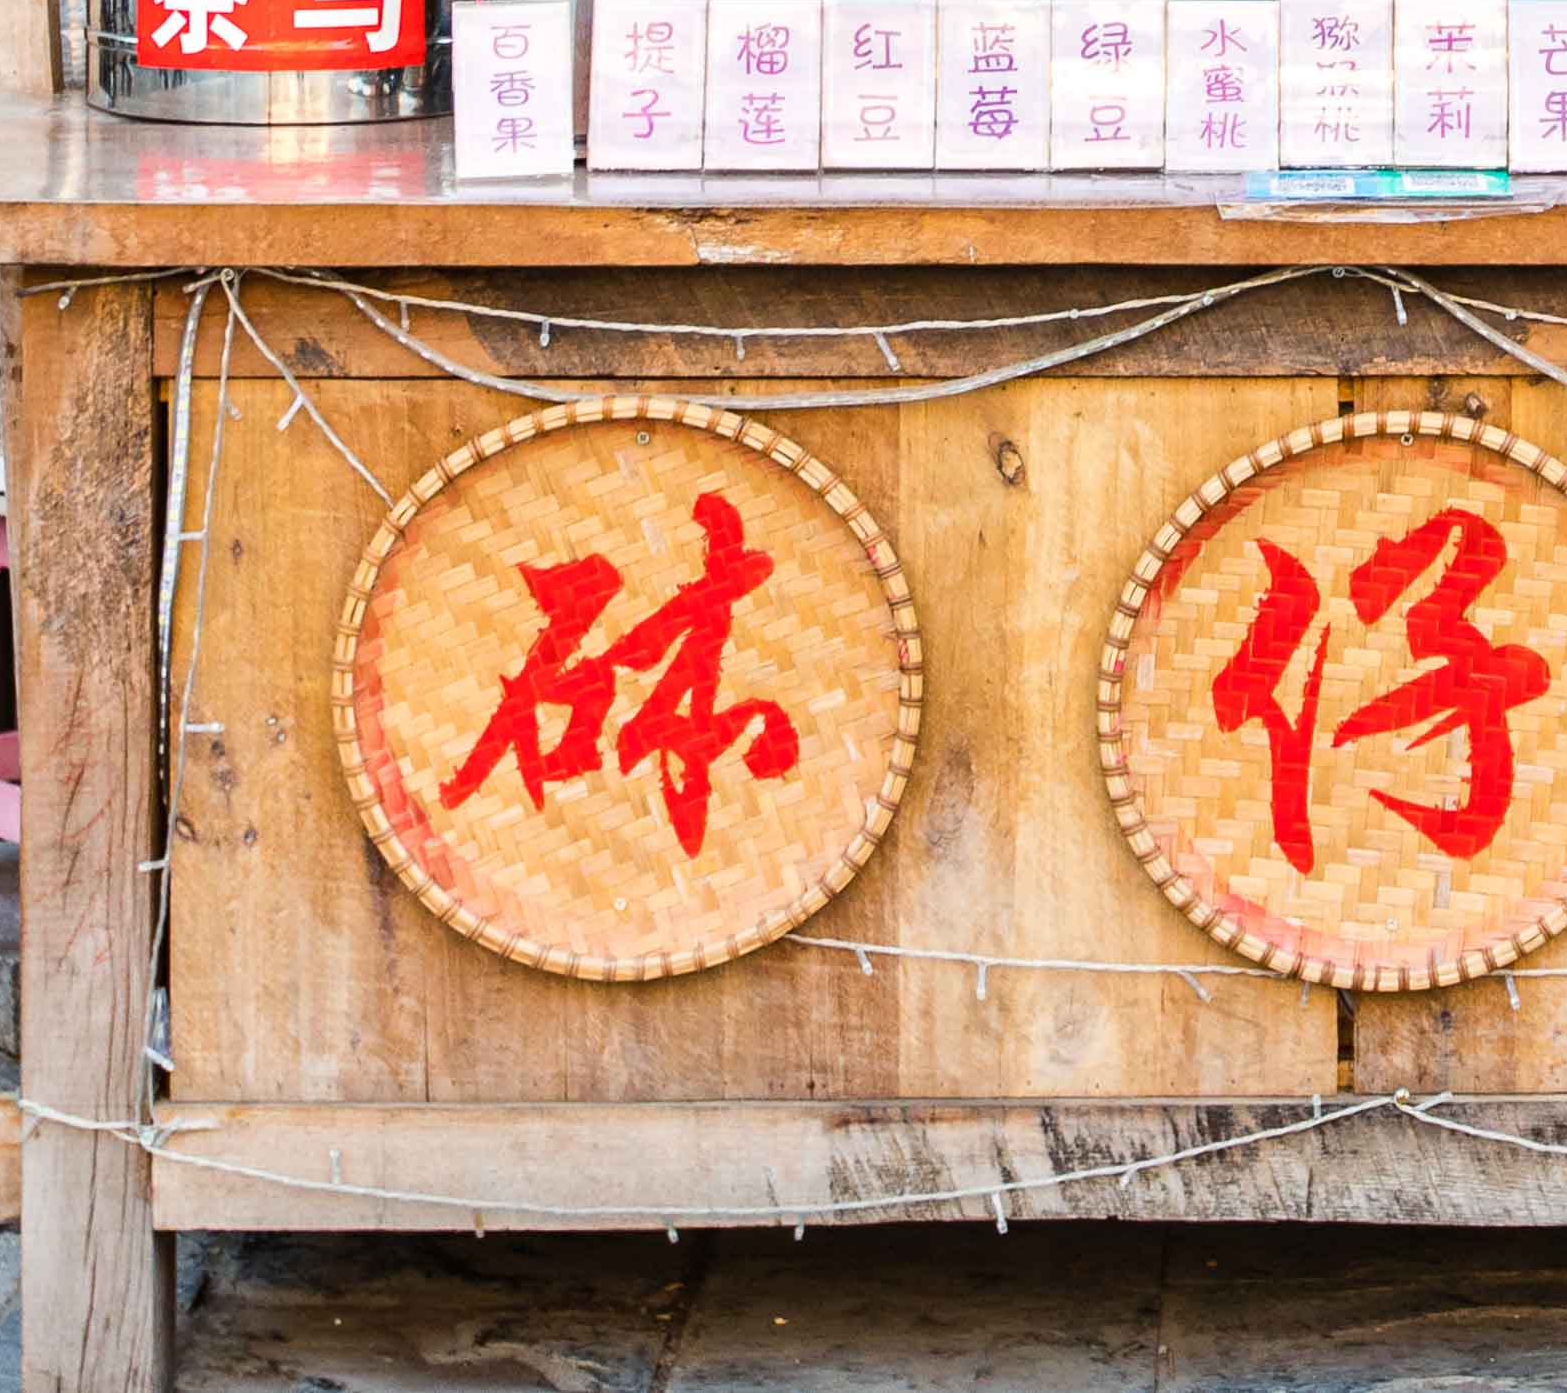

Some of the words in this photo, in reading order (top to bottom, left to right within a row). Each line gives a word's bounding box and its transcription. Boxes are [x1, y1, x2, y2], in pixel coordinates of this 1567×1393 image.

[490, 24, 537, 153] 百香果
[623, 21, 672, 140] 提子
[737, 23, 790, 146] 榴莲
[853, 22, 903, 142] 红豆
[968, 22, 1019, 140] 蓝莓
[1080, 21, 1132, 142] 绿豆
[1200, 19, 1248, 150] 水蜜桃
[1425, 21, 1476, 139] 茉莉
